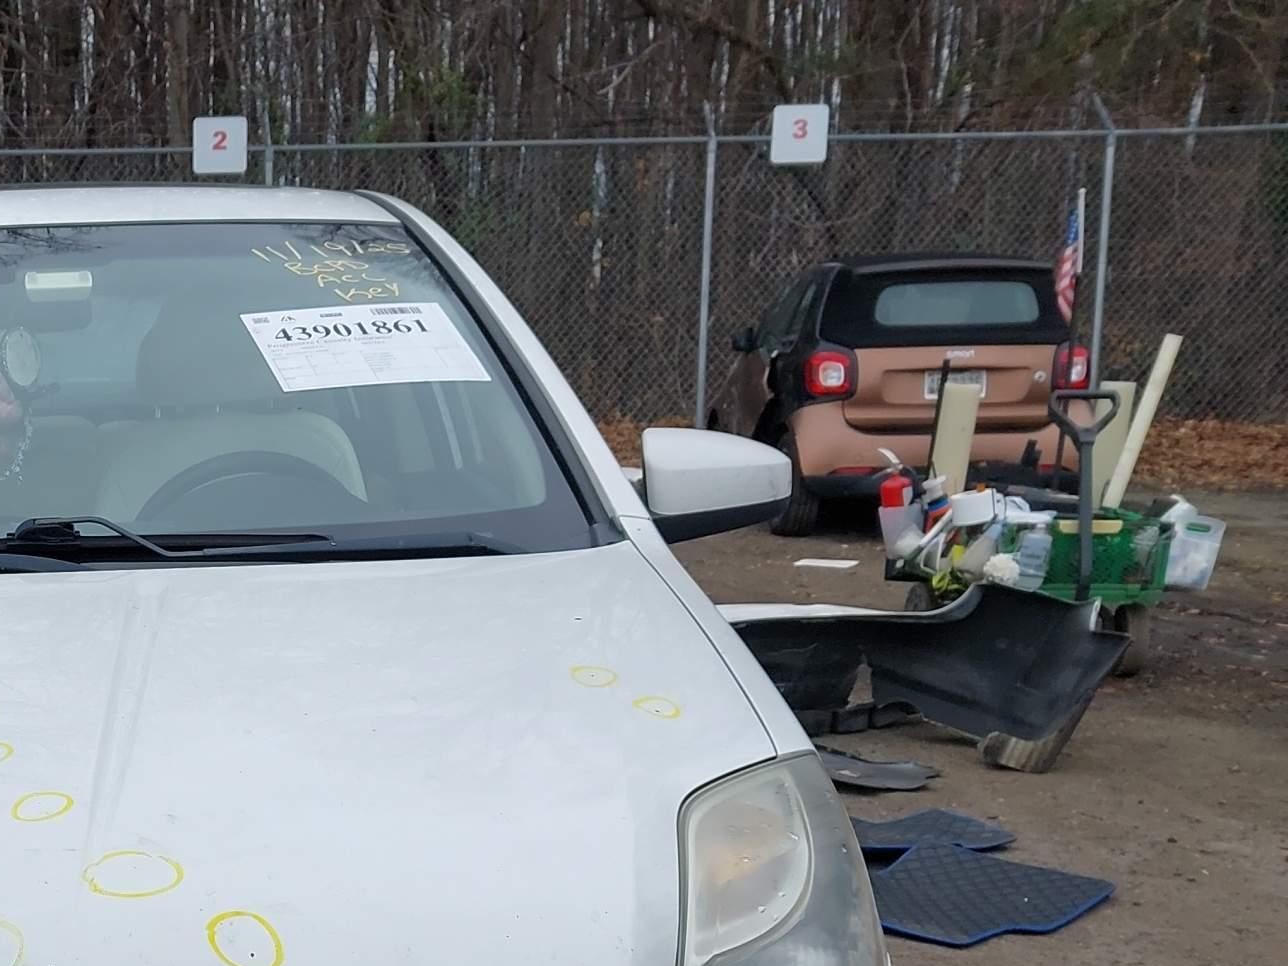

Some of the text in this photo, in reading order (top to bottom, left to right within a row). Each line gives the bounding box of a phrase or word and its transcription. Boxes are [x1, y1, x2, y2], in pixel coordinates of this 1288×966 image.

[792, 119, 809, 140] 3
[212, 130, 228, 151] 2
[274, 319, 429, 342] 43901861
